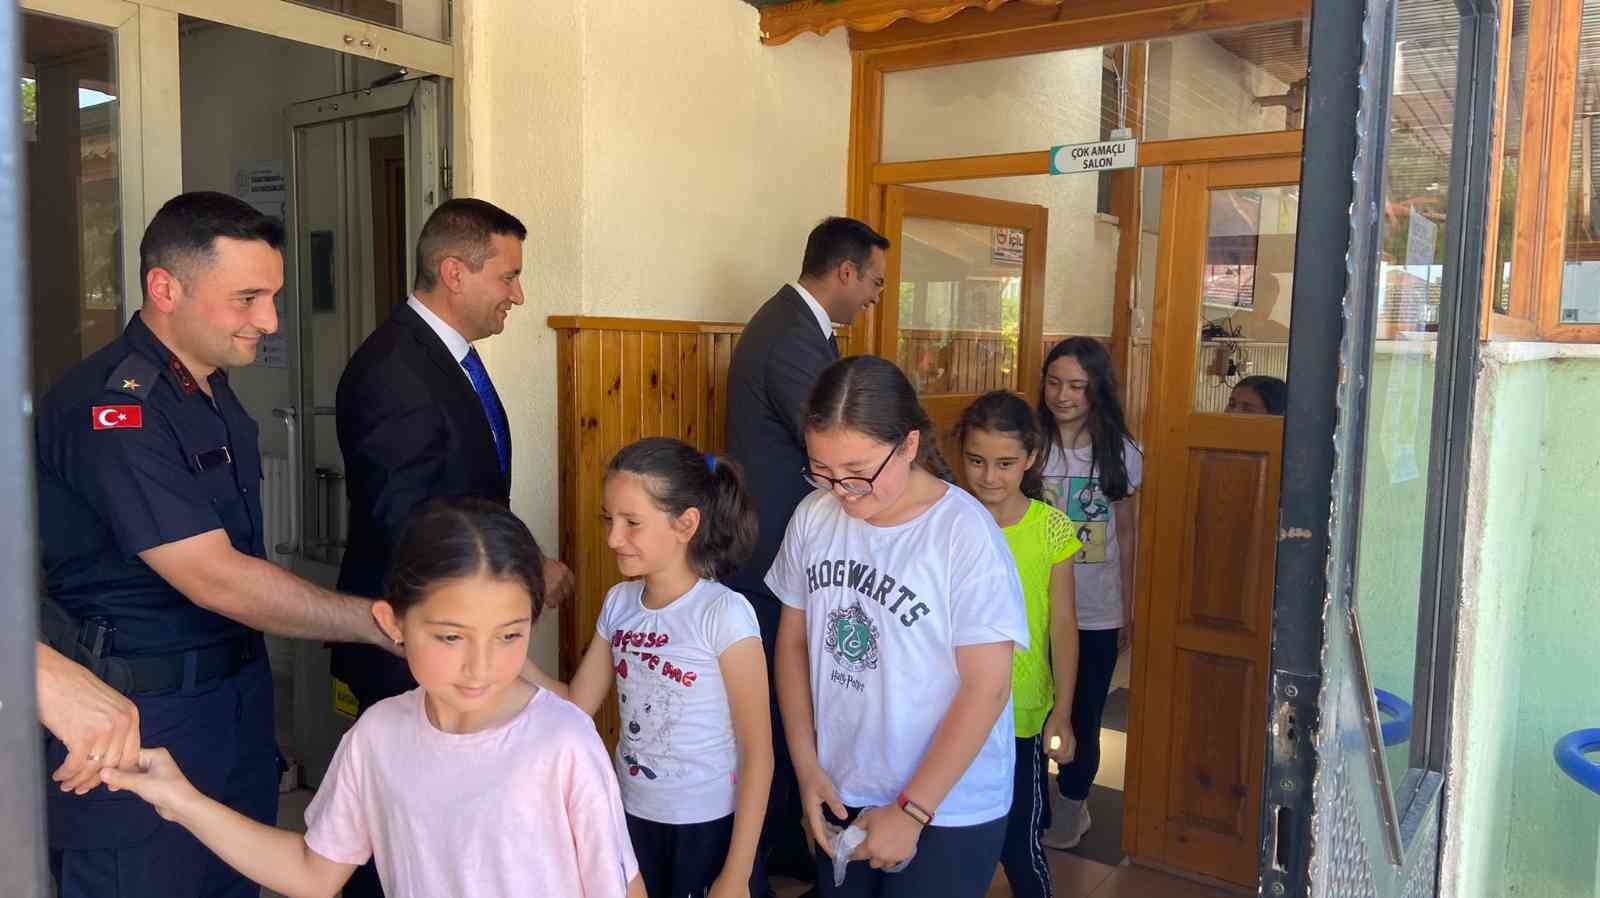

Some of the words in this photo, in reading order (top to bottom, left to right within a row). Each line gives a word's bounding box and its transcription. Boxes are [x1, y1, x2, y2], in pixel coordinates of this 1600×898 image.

[1071, 147, 1090, 160] ÇOK
[1091, 143, 1126, 157] AMAÇLI
[1083, 157, 1113, 169] SALON
[806, 560, 930, 627] HOGWARTS
